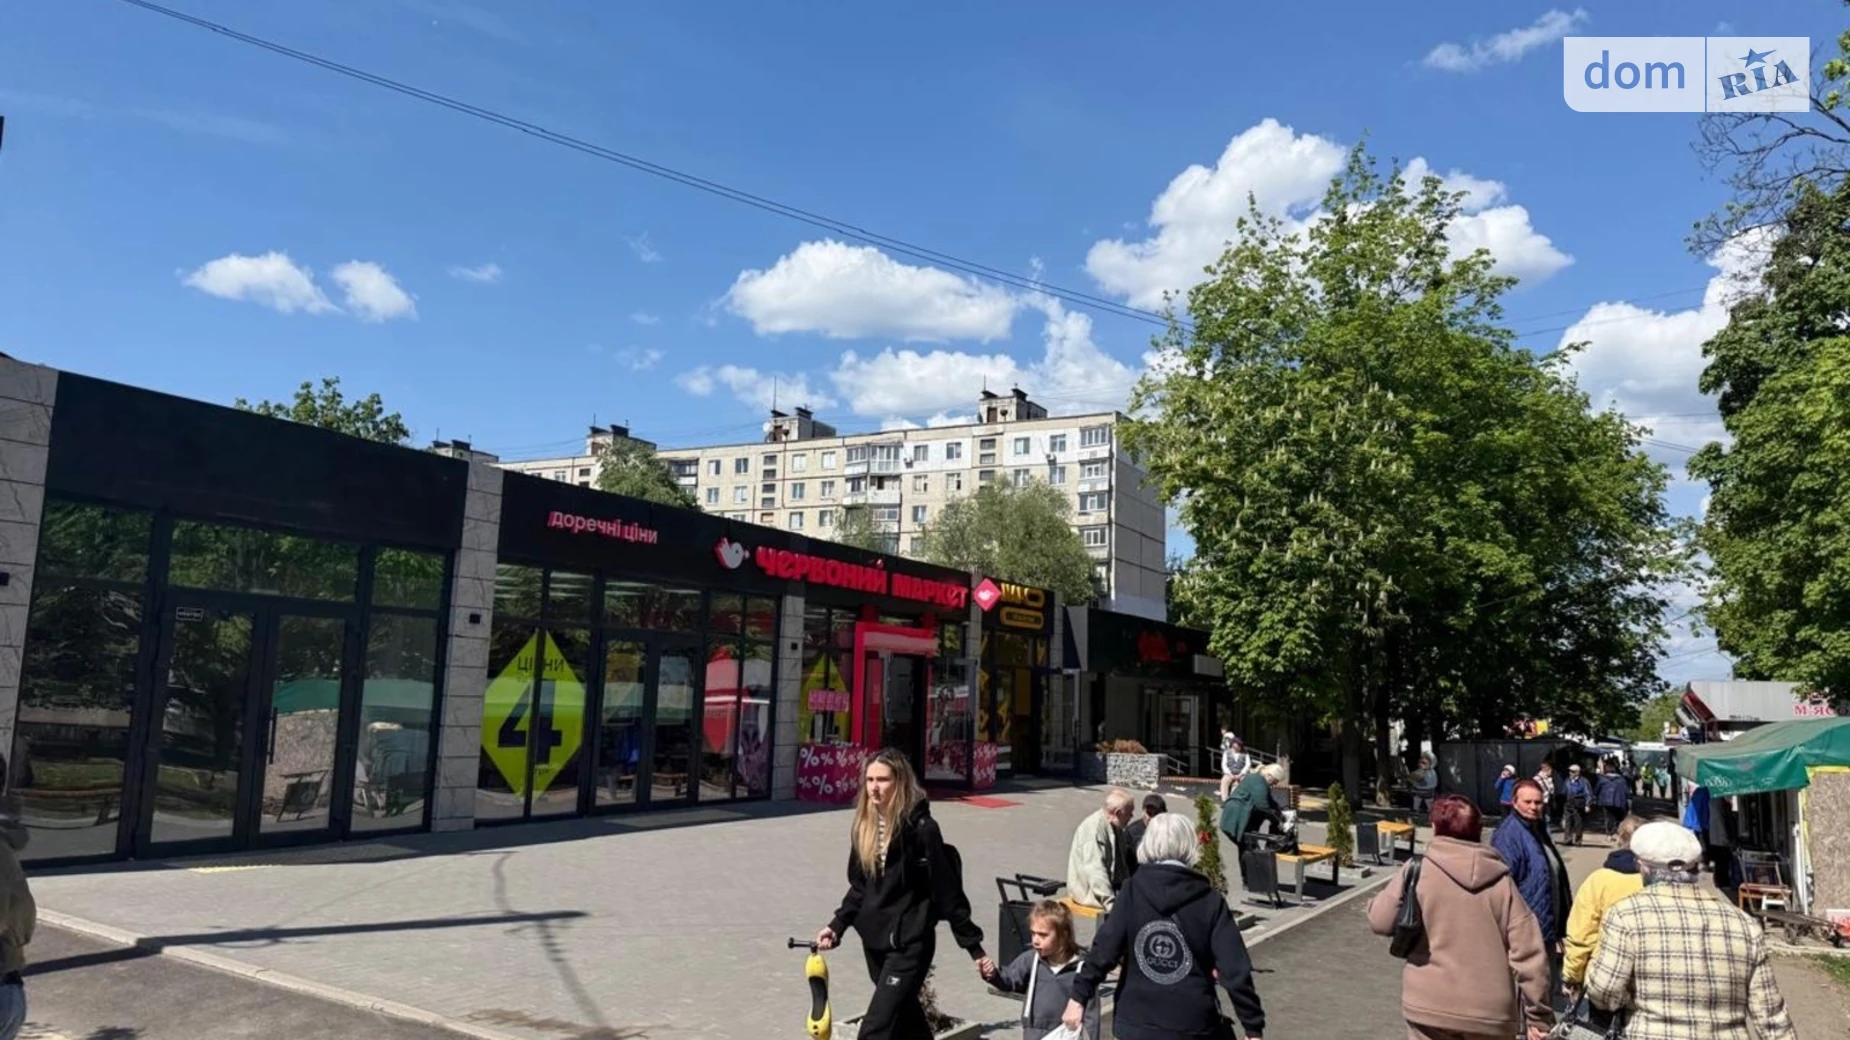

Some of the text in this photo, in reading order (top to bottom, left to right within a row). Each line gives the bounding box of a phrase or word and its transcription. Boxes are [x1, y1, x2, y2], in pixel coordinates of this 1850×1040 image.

[549, 511, 658, 544] доречні ціни
[518, 656, 564, 673] ЦІНИ
[498, 678, 562, 764] 4
